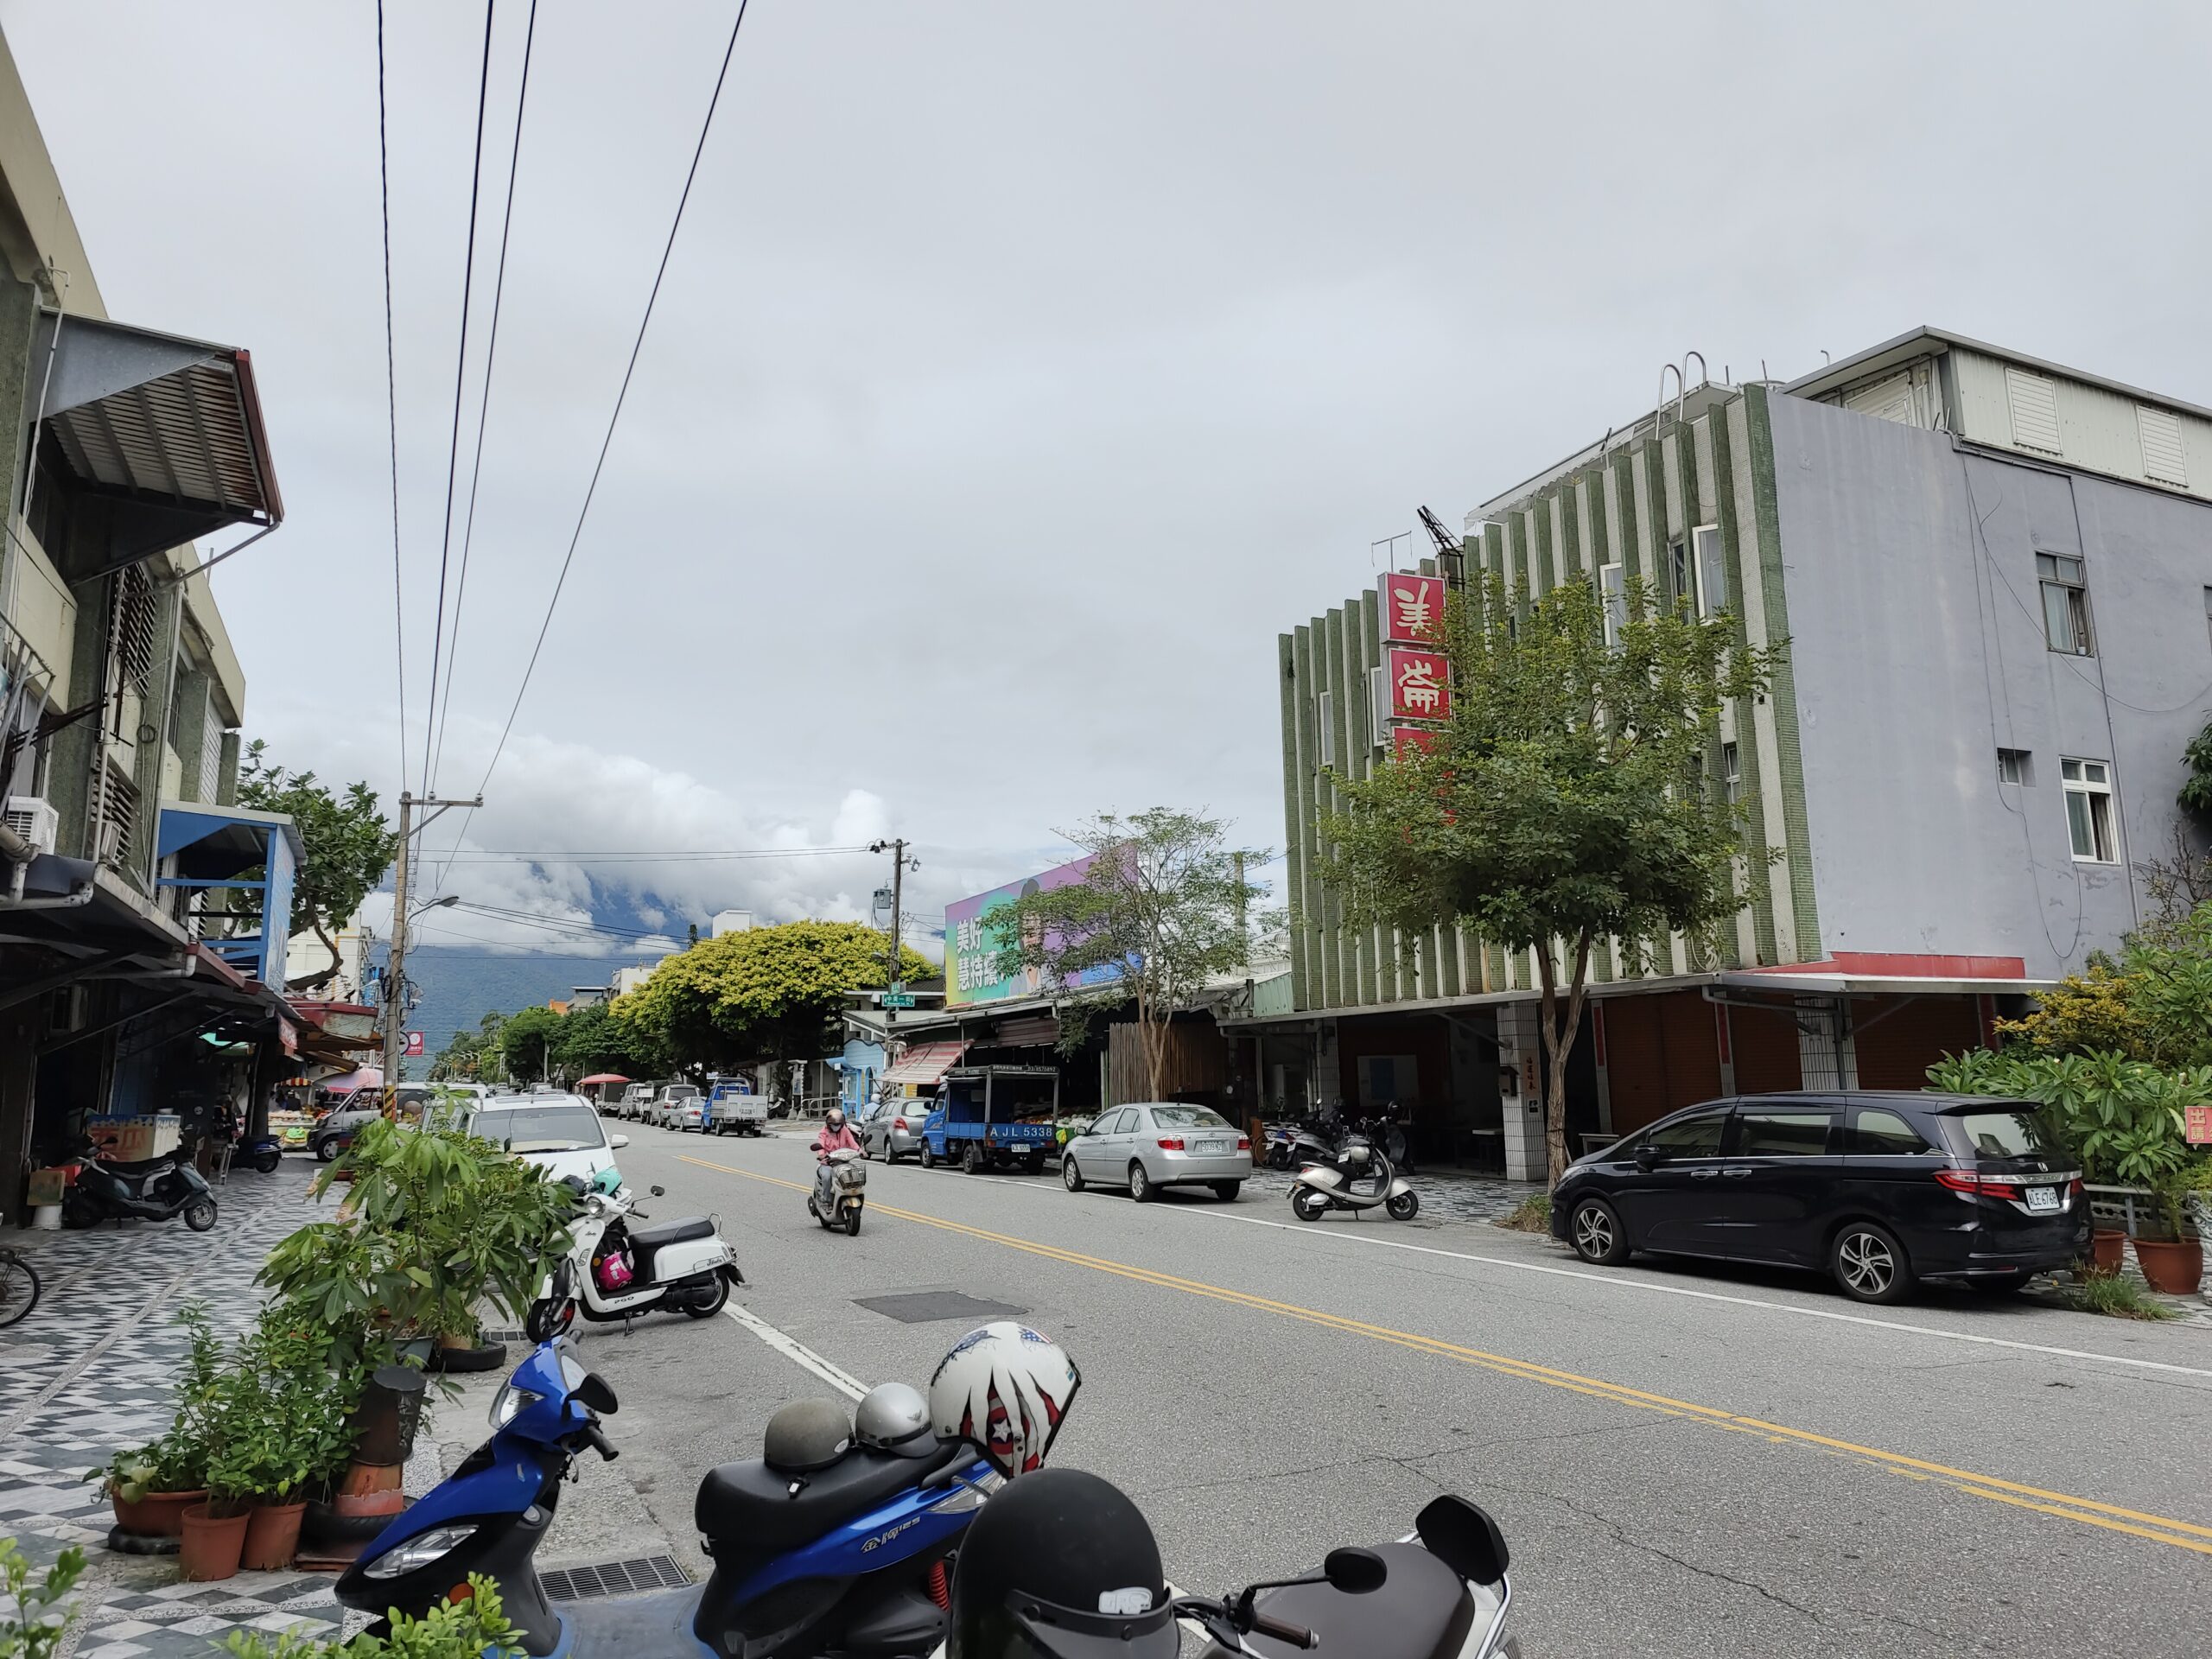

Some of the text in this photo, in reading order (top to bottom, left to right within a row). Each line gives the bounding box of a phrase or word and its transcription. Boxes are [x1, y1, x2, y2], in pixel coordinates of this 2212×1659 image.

[957, 917, 983, 955] 美好
[2190, 1109, 2206, 1125] 出
[989, 1127, 1052, 1137] AJL 5338
[2190, 1126, 2212, 1141] 請
